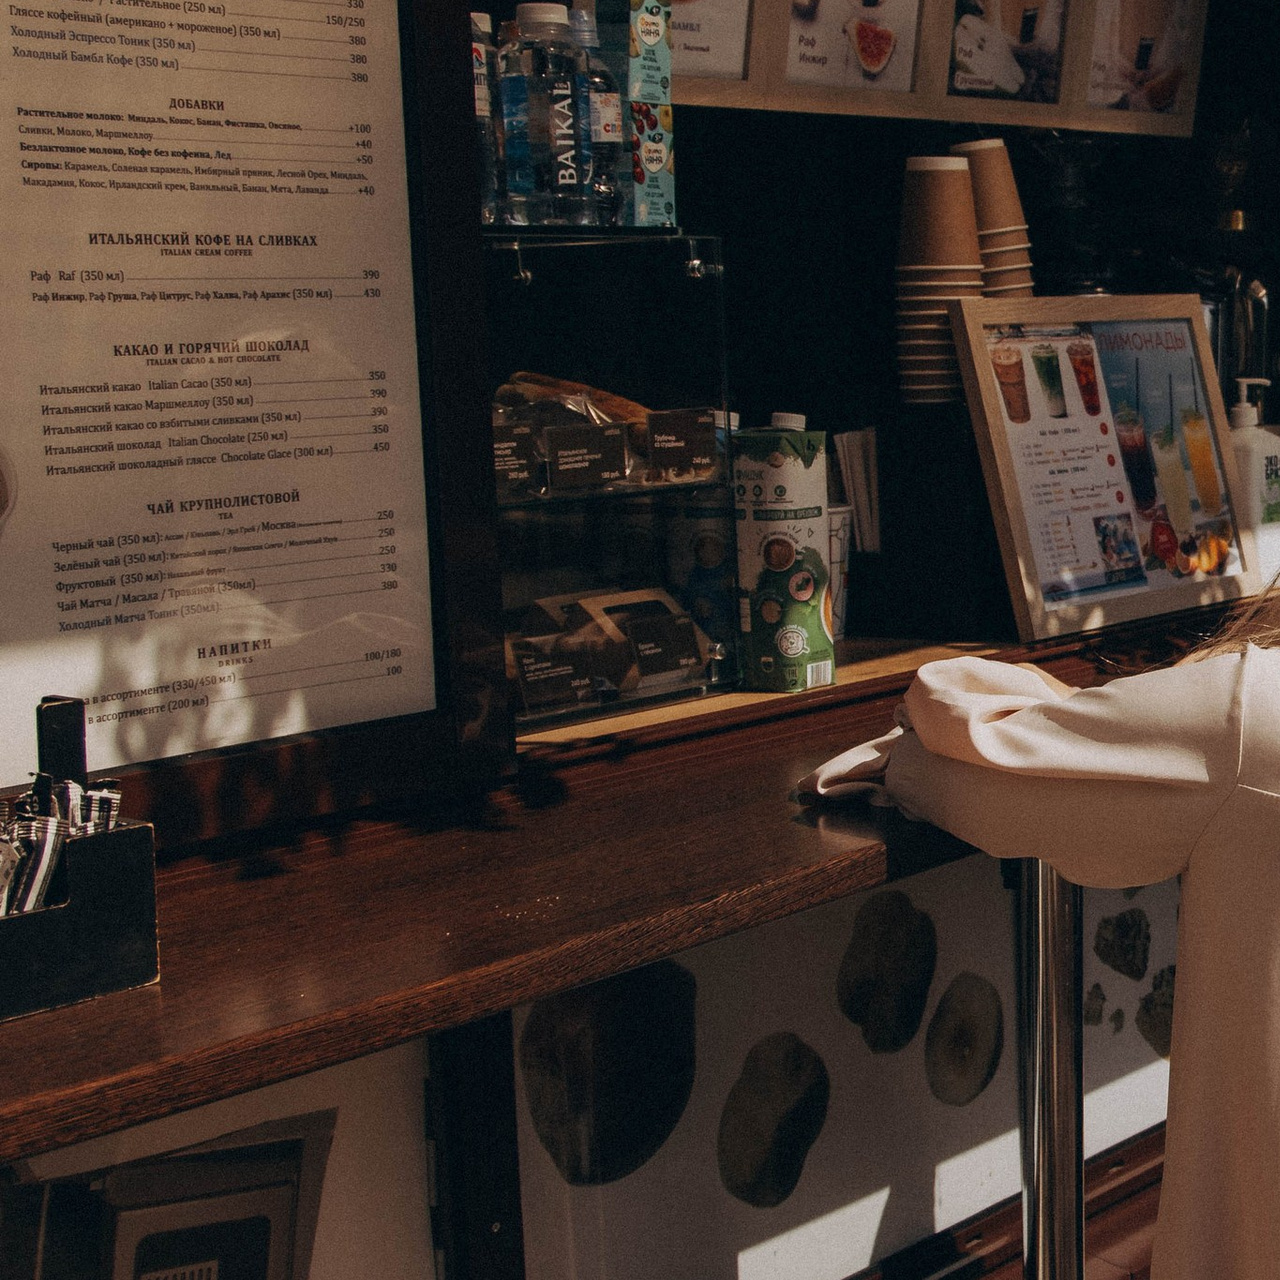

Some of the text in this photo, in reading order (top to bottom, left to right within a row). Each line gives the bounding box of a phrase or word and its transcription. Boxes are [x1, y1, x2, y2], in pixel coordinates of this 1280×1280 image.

[9, 4, 366, 46] Гляссе кофейный (американо мороженое) (350 мл) 380
[183, 1, 206, 14] (250
[208, 4, 226, 16] мл)
[326, 15, 365, 28] 150/250
[799, 35, 816, 48] Раф
[799, 52, 827, 66] Инжир
[170, 98, 225, 111] ДОБАВКИ
[18, 125, 372, 149] Сливки, Молоко, Маршмеллоу +40
[552, 80, 577, 185] BAIKAL
[88, 232, 318, 247] ИТАЛЬЯНСКИЙ КОФЕ НА СЛИВКАХ
[224, 249, 252, 257] COFFEE
[30, 270, 380, 284] Раф Raf (350 мл) 390
[113, 340, 310, 356] КАКАО И ГОРЯЧИЙ ШОКОЛАД
[1099, 332, 1186, 353] ЛИМОНАДЫ
[146, 358, 178, 366] ITALIAN
[181, 357, 206, 365] CACAO
[236, 354, 281, 363] CHOCOLATE
[40, 371, 386, 395] Итальянский какао Italian Cacao (350 мл) 350
[44, 425, 389, 456] Итальянский шоколад Italian Chocolate (250 мл) 350
[46, 442, 390, 476] Итальянский шоколадный гляссе Chocolate Glace (300 мл) 450
[147, 489, 300, 515] ЧАЙ КРУПНОЛИСТОВОЙ
[219, 512, 233, 520] TEA
[52, 539, 93, 553] Черный
[96, 537, 114, 548] чай
[117, 534, 140, 548] (350
[142, 532, 164, 544] мл):
[261, 521, 295, 531] Москва
[377, 510, 394, 520] 250
[54, 558, 100, 572] Зелёный
[103, 556, 121, 567] чай
[123, 554, 145, 567] (350
[148, 550, 169, 563] мл):
[378, 528, 395, 537] 250
[57, 563, 397, 612] Чай Матча Масала Травяной (350мл) 330
[197, 638, 271, 659] НАПИТКИ
[218, 656, 254, 667] DRINKS
[101, 685, 170, 703] ассортименте
[172, 675, 217, 693] (330/450
[219, 672, 236, 684] мл)
[364, 648, 401, 662] 100/180
